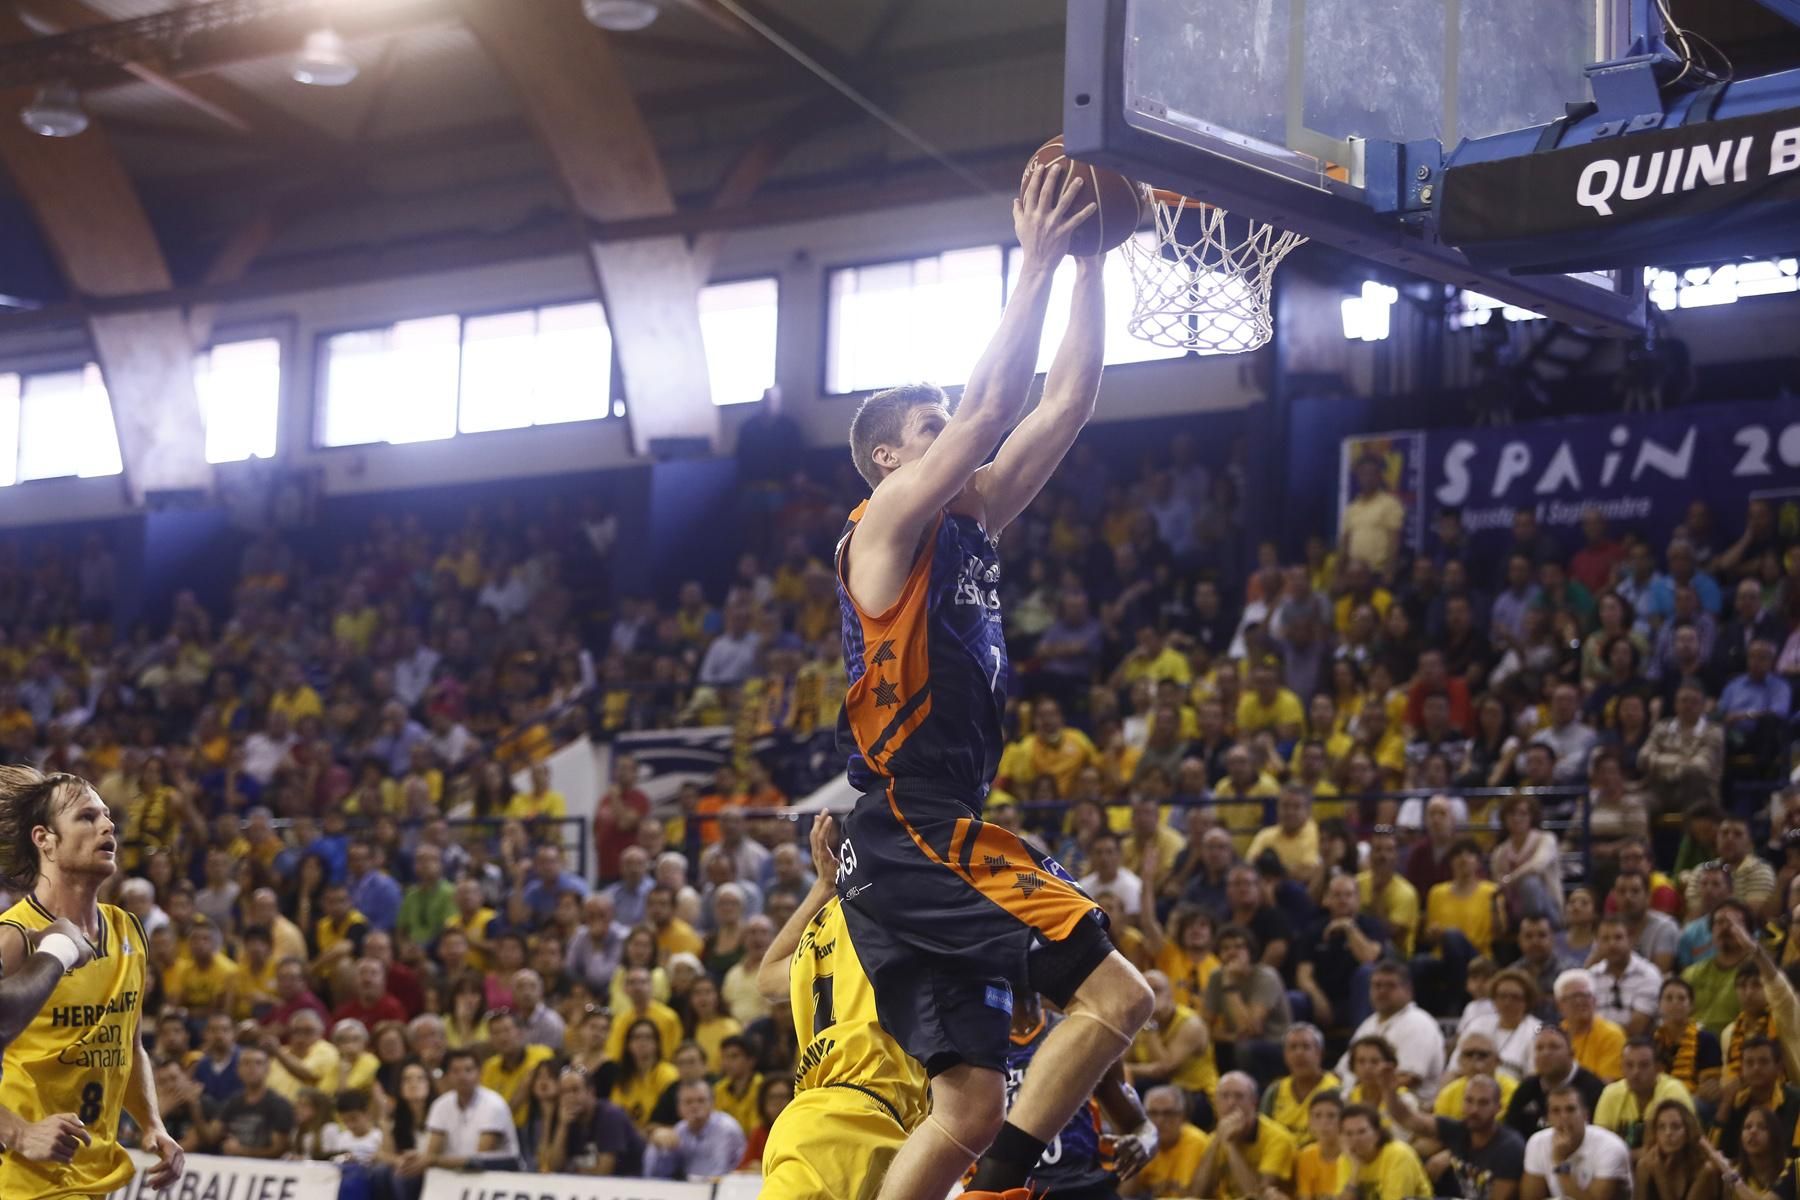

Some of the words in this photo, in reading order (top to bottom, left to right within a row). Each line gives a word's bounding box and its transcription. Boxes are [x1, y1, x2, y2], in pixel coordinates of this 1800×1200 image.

[1576, 136, 1754, 216] QUINI
[990, 644, 1001, 694] 7
[79, 1081, 104, 1125] 8
